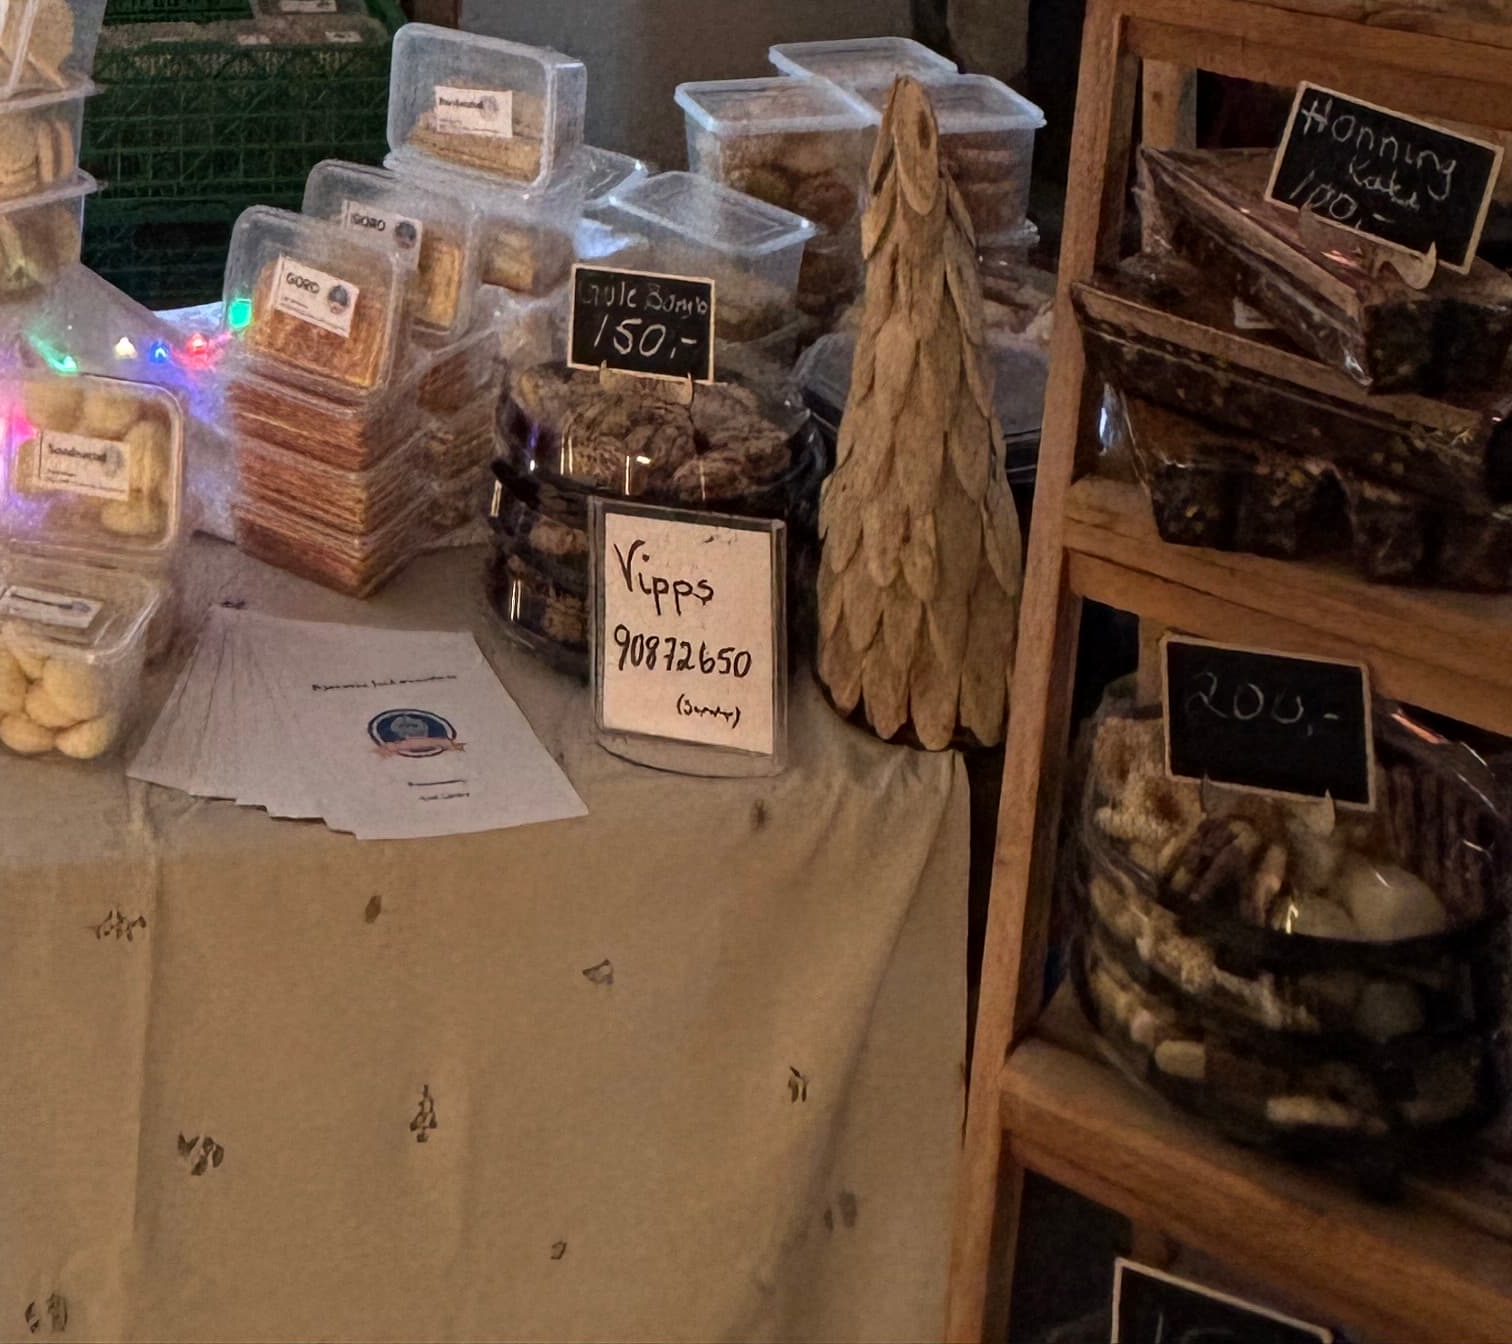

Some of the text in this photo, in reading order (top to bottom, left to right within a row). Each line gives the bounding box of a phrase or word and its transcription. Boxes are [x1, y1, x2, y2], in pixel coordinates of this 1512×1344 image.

[1301, 99, 1456, 201] Honning
[286, 272, 320, 294] GORO
[593, 313, 697, 359] 150,-
[614, 539, 714, 616] Vipps
[614, 624, 752, 678] 90872650
